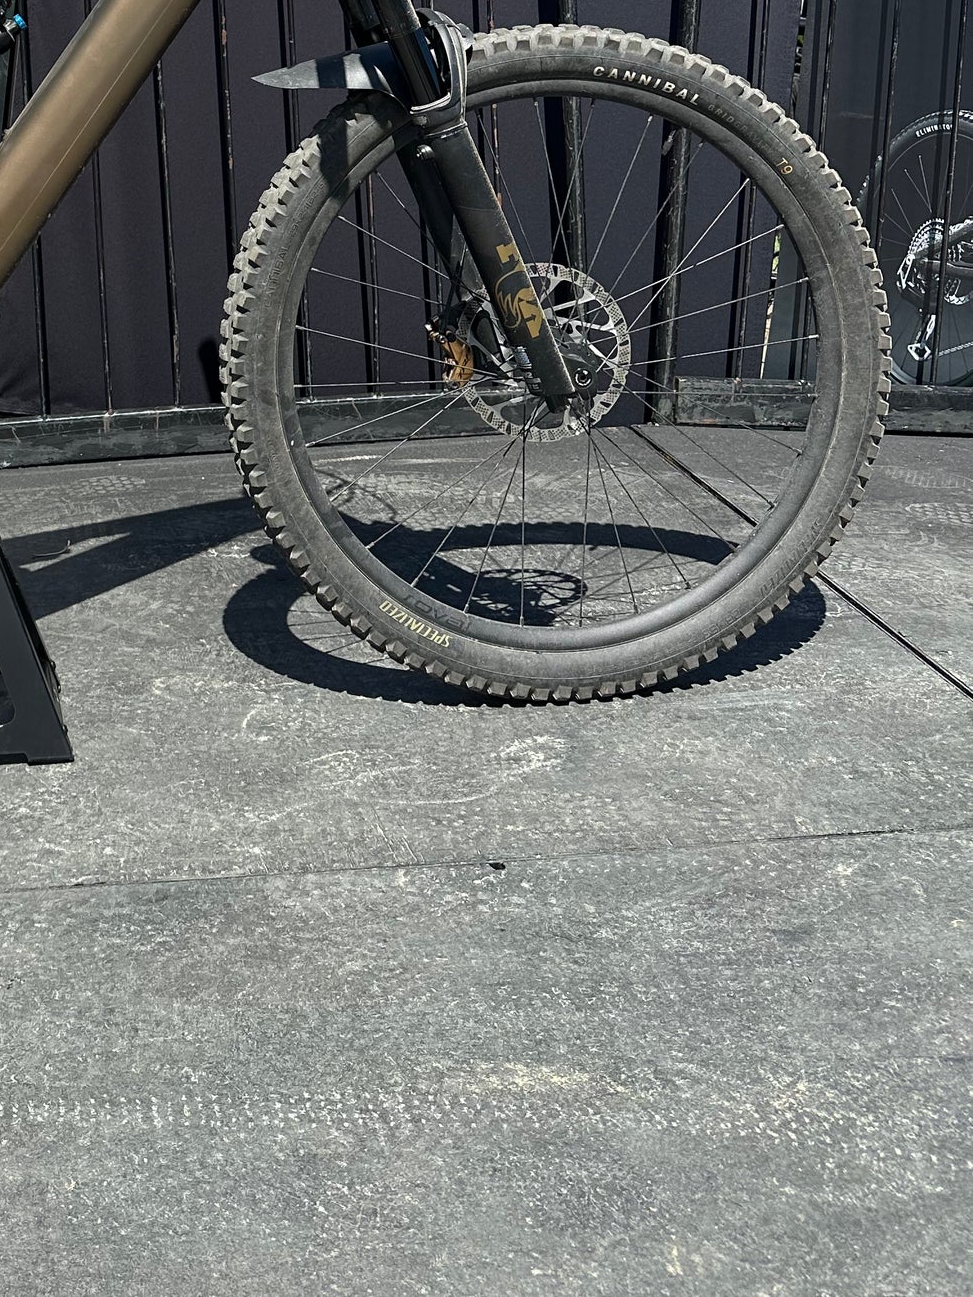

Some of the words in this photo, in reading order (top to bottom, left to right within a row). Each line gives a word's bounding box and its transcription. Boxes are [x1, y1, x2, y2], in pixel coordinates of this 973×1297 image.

[592, 66, 700, 106] CANNIBAL
[708, 104, 735, 123] GRID
[776, 157, 794, 175] T9
[379, 600, 453, 648] SPECIALIZED
